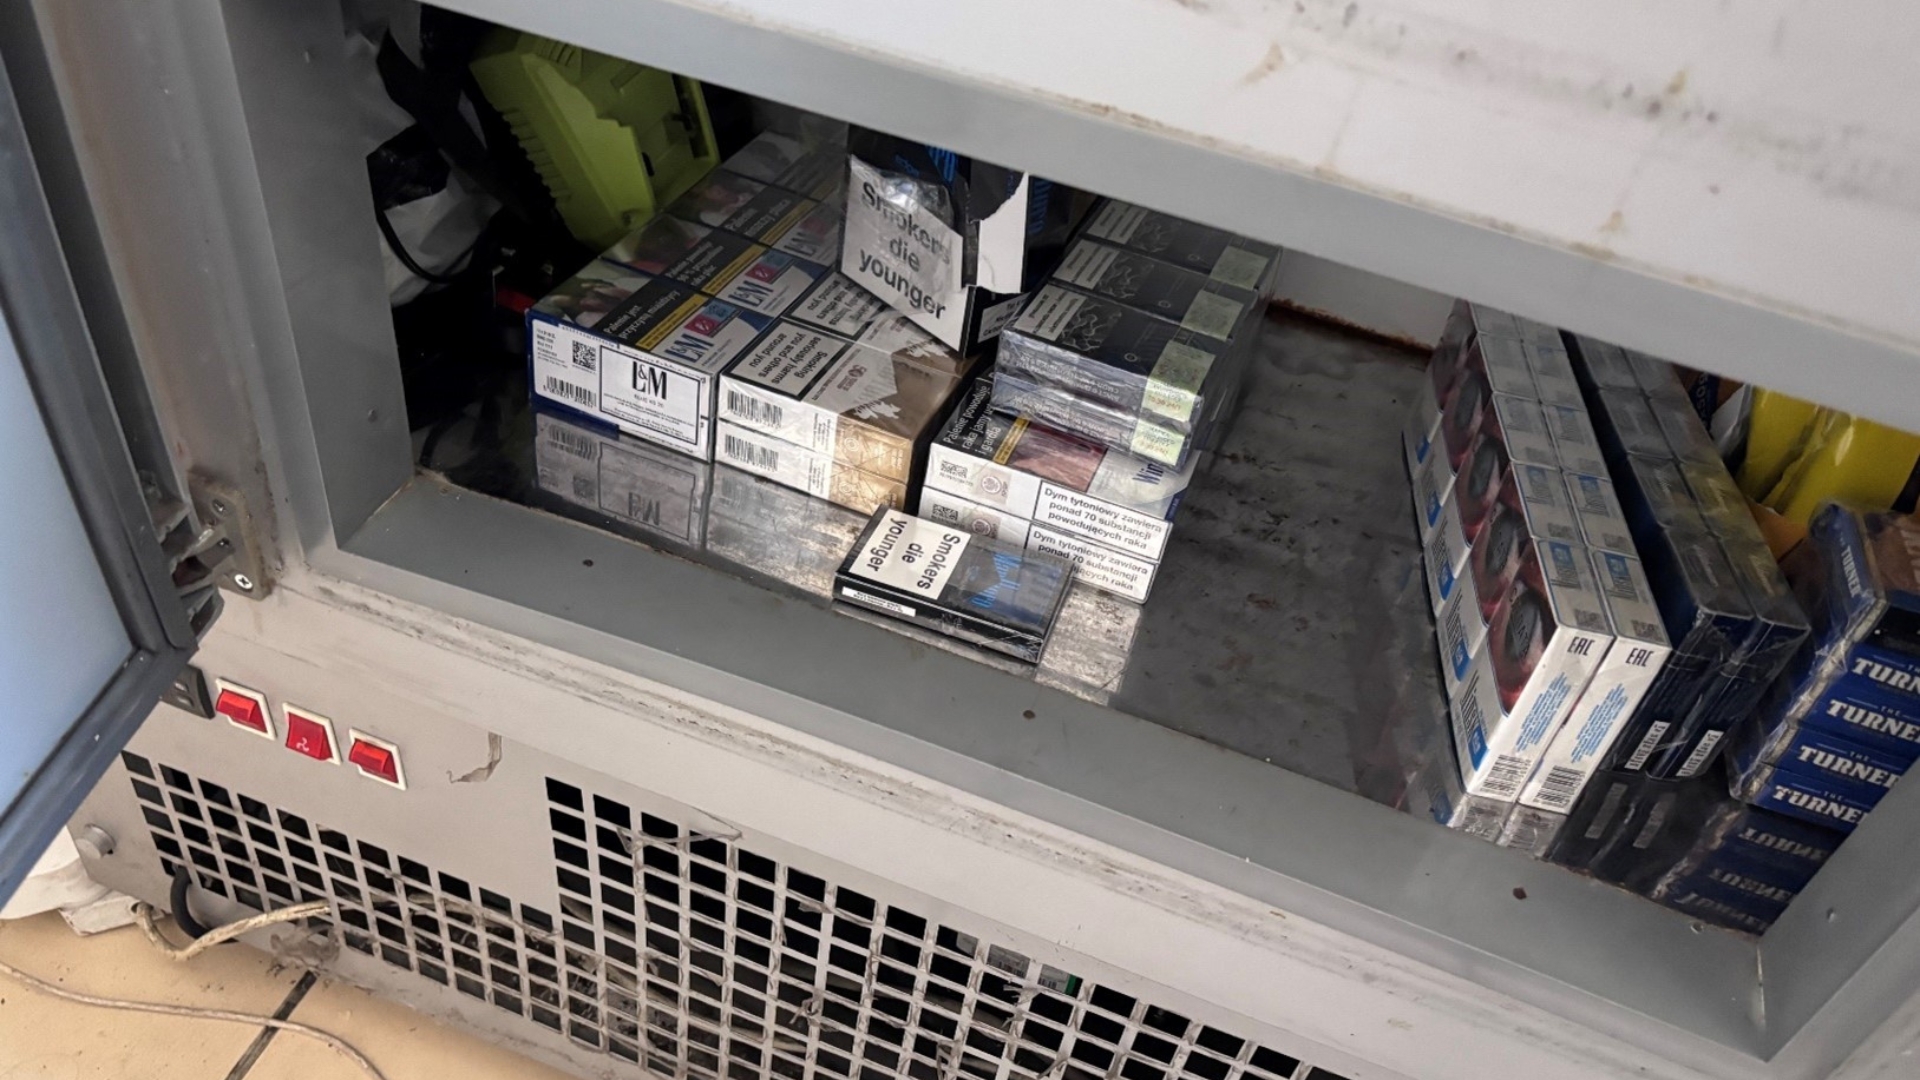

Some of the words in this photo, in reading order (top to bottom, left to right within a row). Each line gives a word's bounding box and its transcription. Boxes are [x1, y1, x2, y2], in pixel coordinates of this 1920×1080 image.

[862, 182, 949, 264] Smokers
[890, 236, 919, 272] die
[728, 280, 773, 308] L&M
[859, 249, 945, 319] younger
[665, 333, 714, 363] L&M
[767, 332, 787, 357] around
[780, 343, 794, 361] and
[791, 331, 807, 348] you
[795, 335, 822, 366] seriously
[749, 353, 766, 368] you
[758, 357, 782, 378] others
[771, 361, 795, 385] harms
[794, 351, 829, 379] Smoking
[632, 361, 667, 400] L&M
[943, 417, 968, 445] Palenie
[962, 385, 991, 418] powoduje
[969, 413, 992, 434] jamy
[962, 432, 978, 449] raka
[981, 426, 1002, 452] gardła
[1043, 487, 1069, 502] Dym
[1069, 493, 1120, 519] tytoniowy
[1120, 511, 1162, 533] zawiera
[1049, 501, 1082, 519] ponad
[1083, 510, 1097, 521] 70
[1098, 514, 1152, 541] substancji
[867, 517, 908, 572] younger
[1047, 512, 1122, 542] powodujących
[1123, 533, 1148, 549] raka
[902, 542, 924, 565] die
[917, 533, 960, 590] Smokers
[1033, 530, 1057, 546] Dym
[1057, 536, 1106, 562] tytoniowy
[1106, 555, 1148, 575] zawiera
[1037, 544, 1071, 562] ponad
[1071, 553, 1085, 564] 70
[1110, 576, 1134, 591] raka
[1841, 545, 1861, 598] TURNER
[1826, 699, 1920, 743] TURNE
[1881, 706, 1901, 717] THE
[1849, 751, 1870, 762] THE
[1772, 785, 1867, 822] TURNE
[1823, 790, 1843, 801] THE
